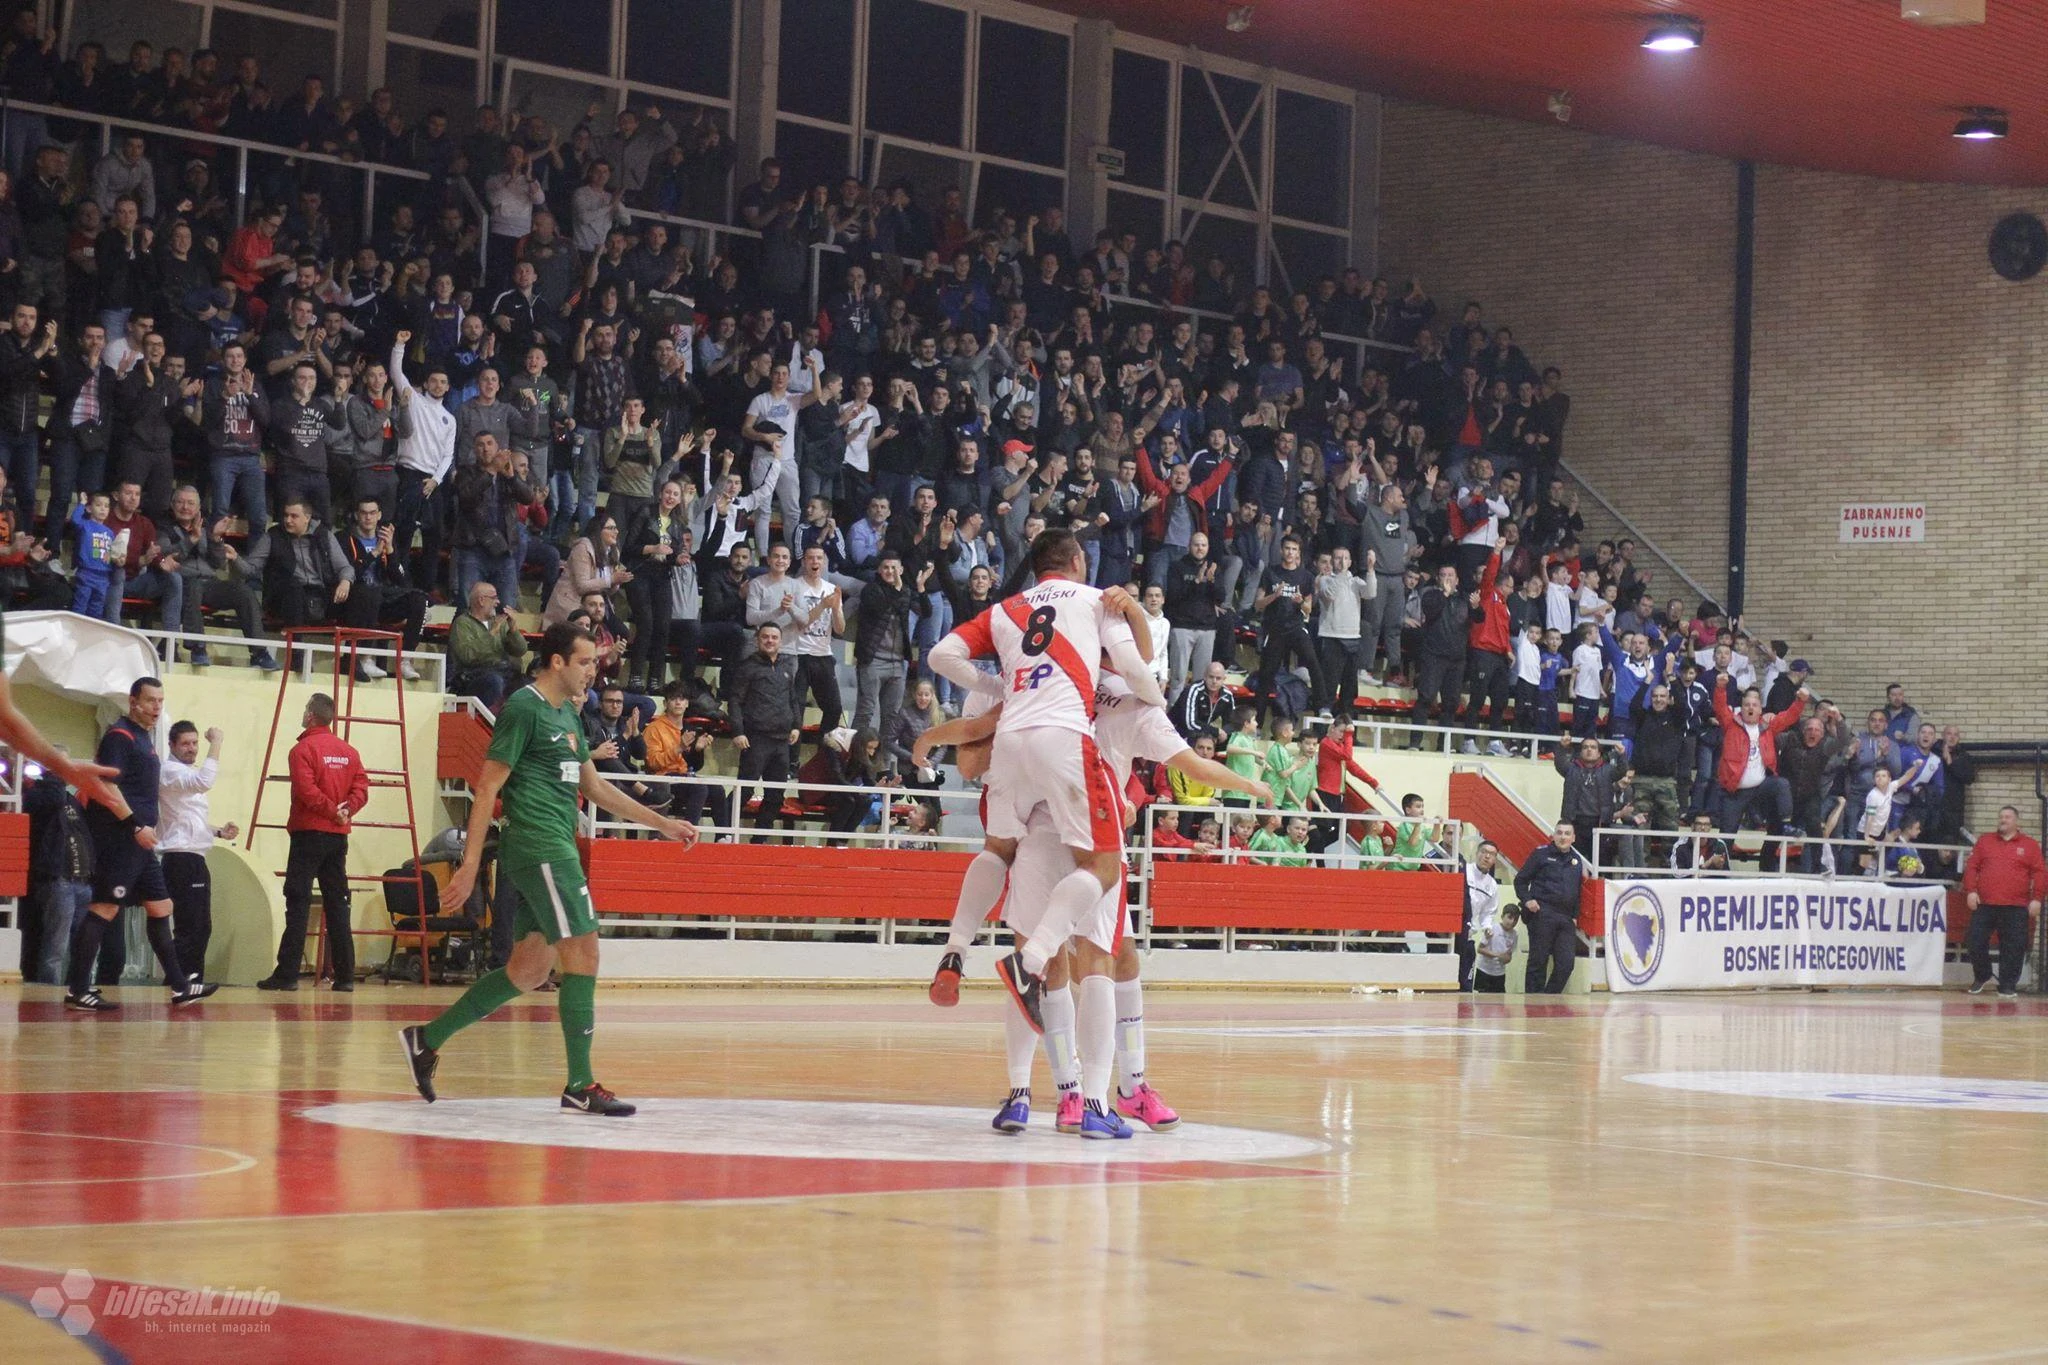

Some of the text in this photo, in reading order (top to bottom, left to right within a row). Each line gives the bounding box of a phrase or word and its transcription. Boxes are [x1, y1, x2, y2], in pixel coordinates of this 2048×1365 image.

[1843, 507, 1923, 520] ZABRANJENO
[1852, 522, 1911, 538] PUŠENJE
[1022, 605, 1057, 657] 8
[1013, 664, 1054, 693] EP
[1680, 895, 1946, 932] PREMIJER FUTSAL LIGA
[1723, 945, 1906, 972] BOSNE I HERCEGOVINE
